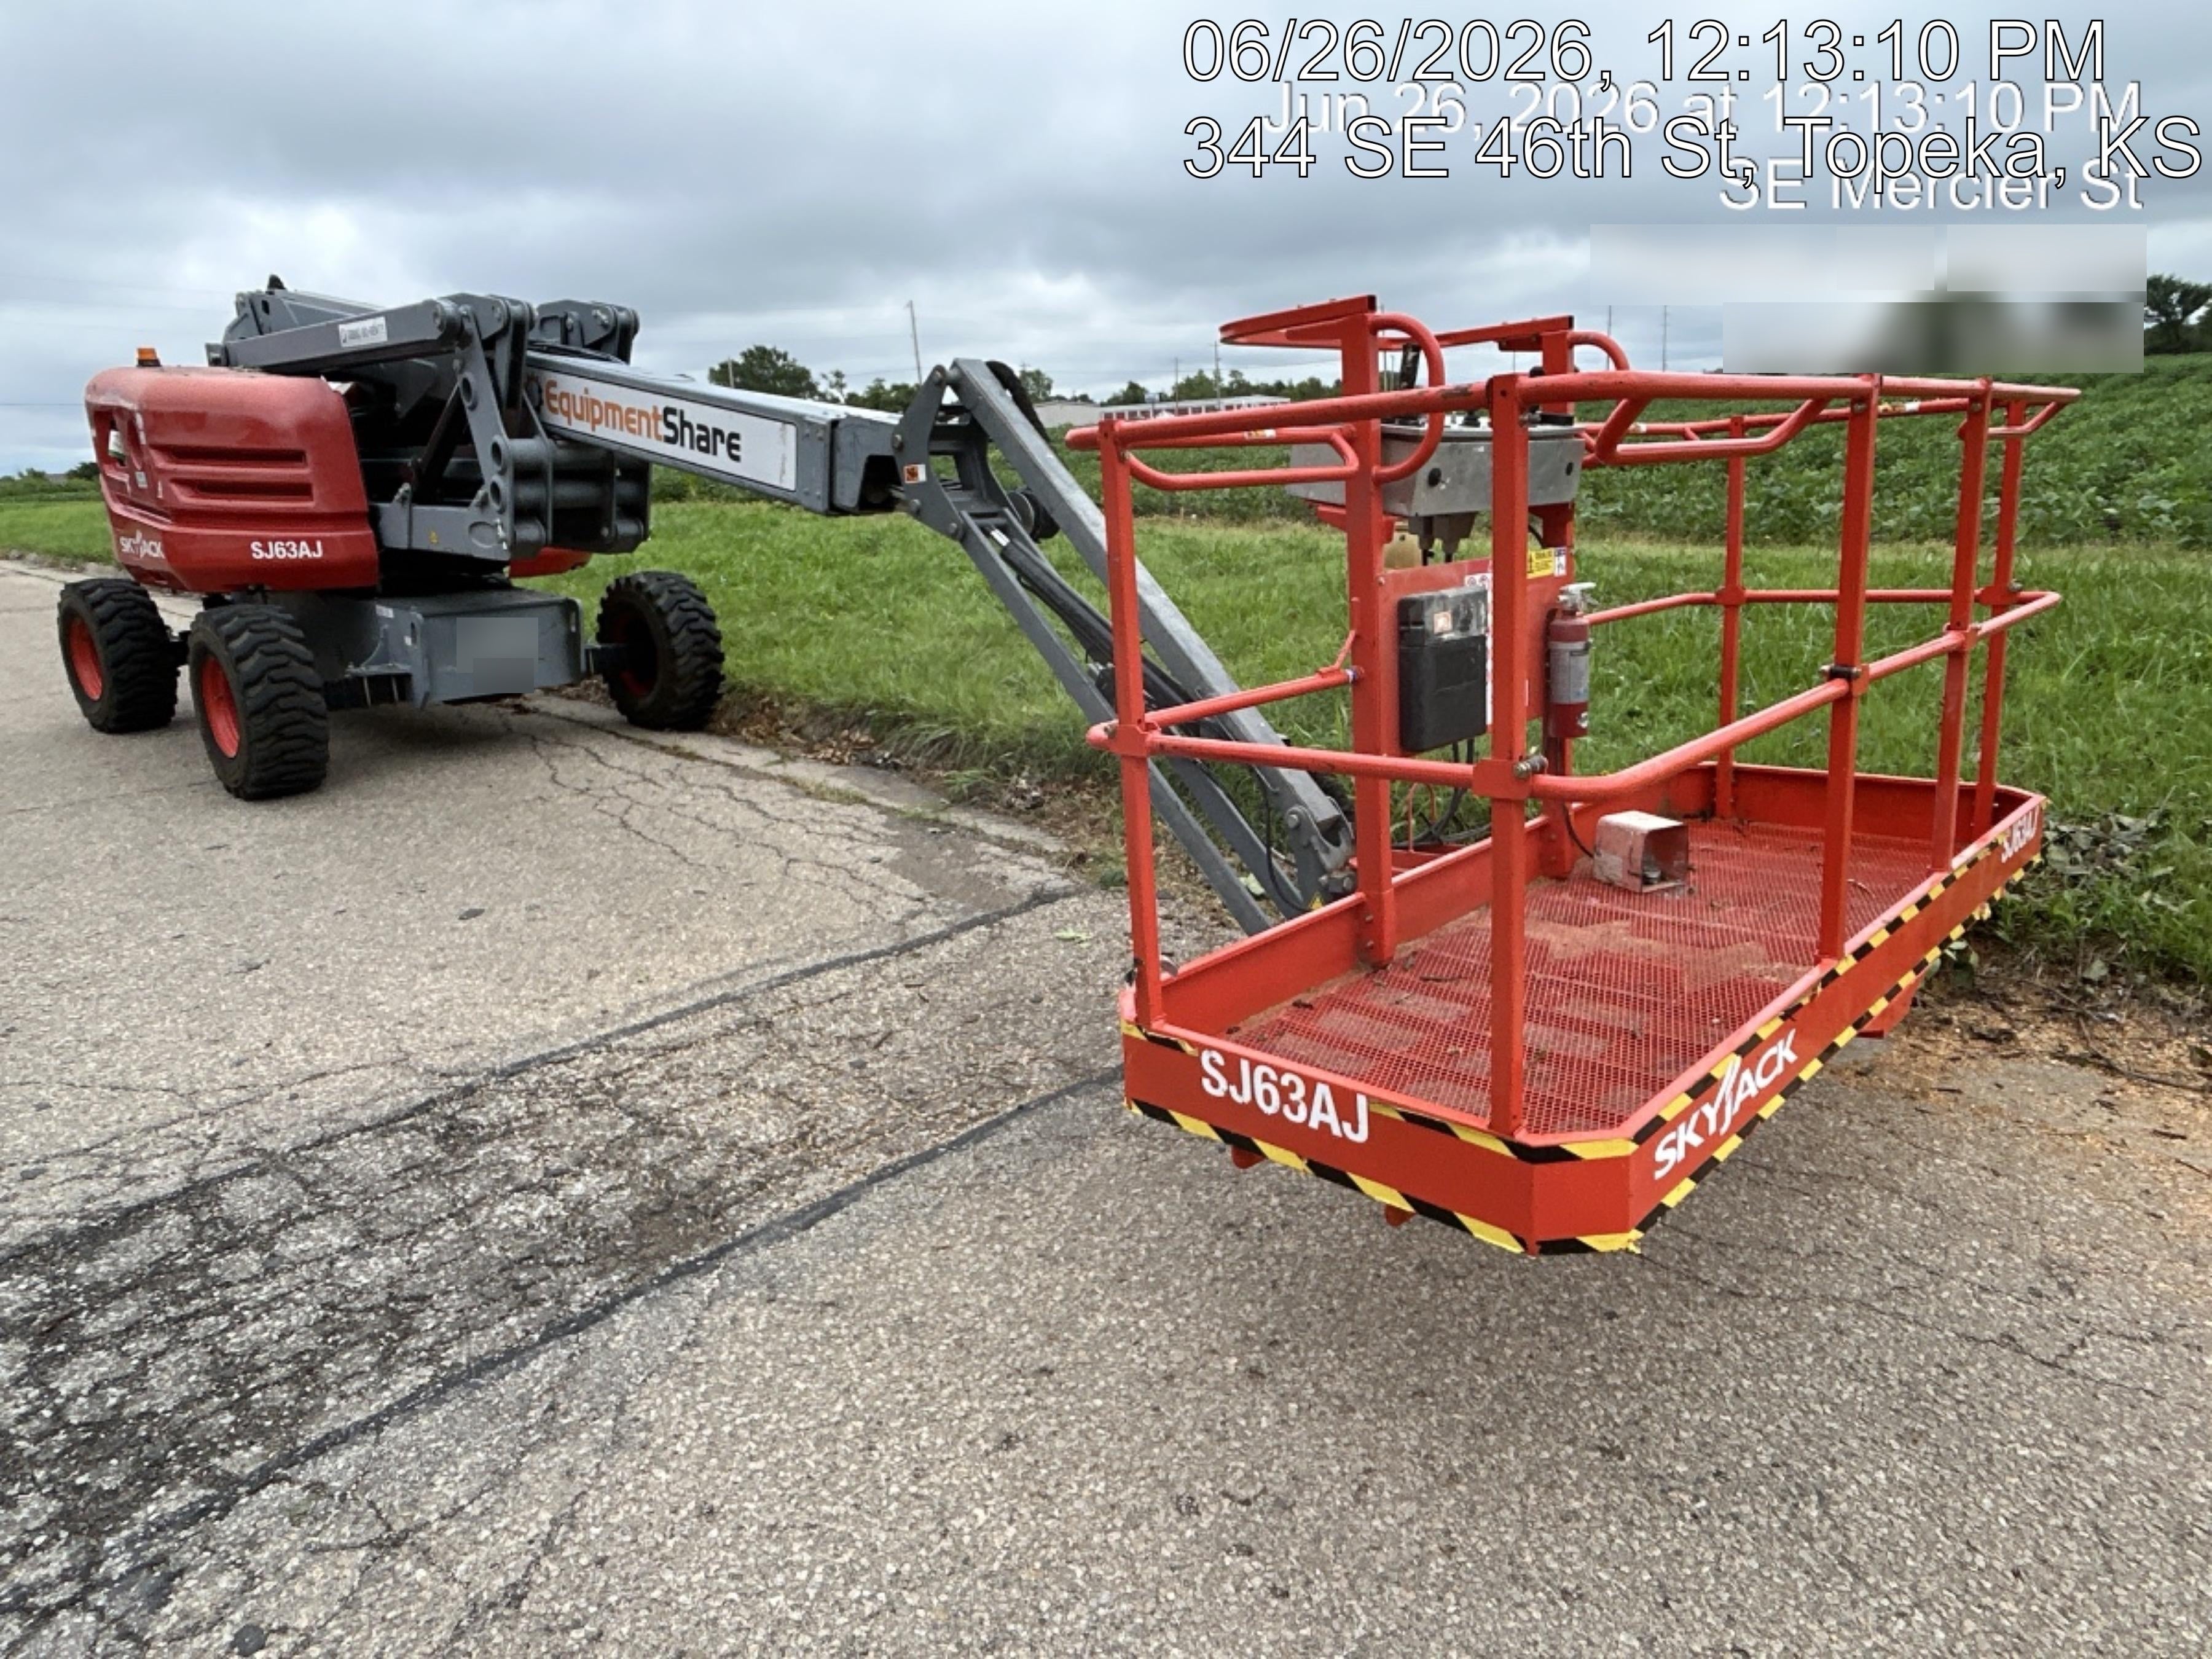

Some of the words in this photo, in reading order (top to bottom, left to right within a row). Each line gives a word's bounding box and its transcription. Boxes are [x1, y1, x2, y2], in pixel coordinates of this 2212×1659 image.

[544, 379, 741, 462] EquipmentShare
[250, 540, 323, 559] SJ63AJ
[1200, 1048, 1369, 1143] SJ63AJ
[1654, 1028, 1798, 1180] SKYJACK
